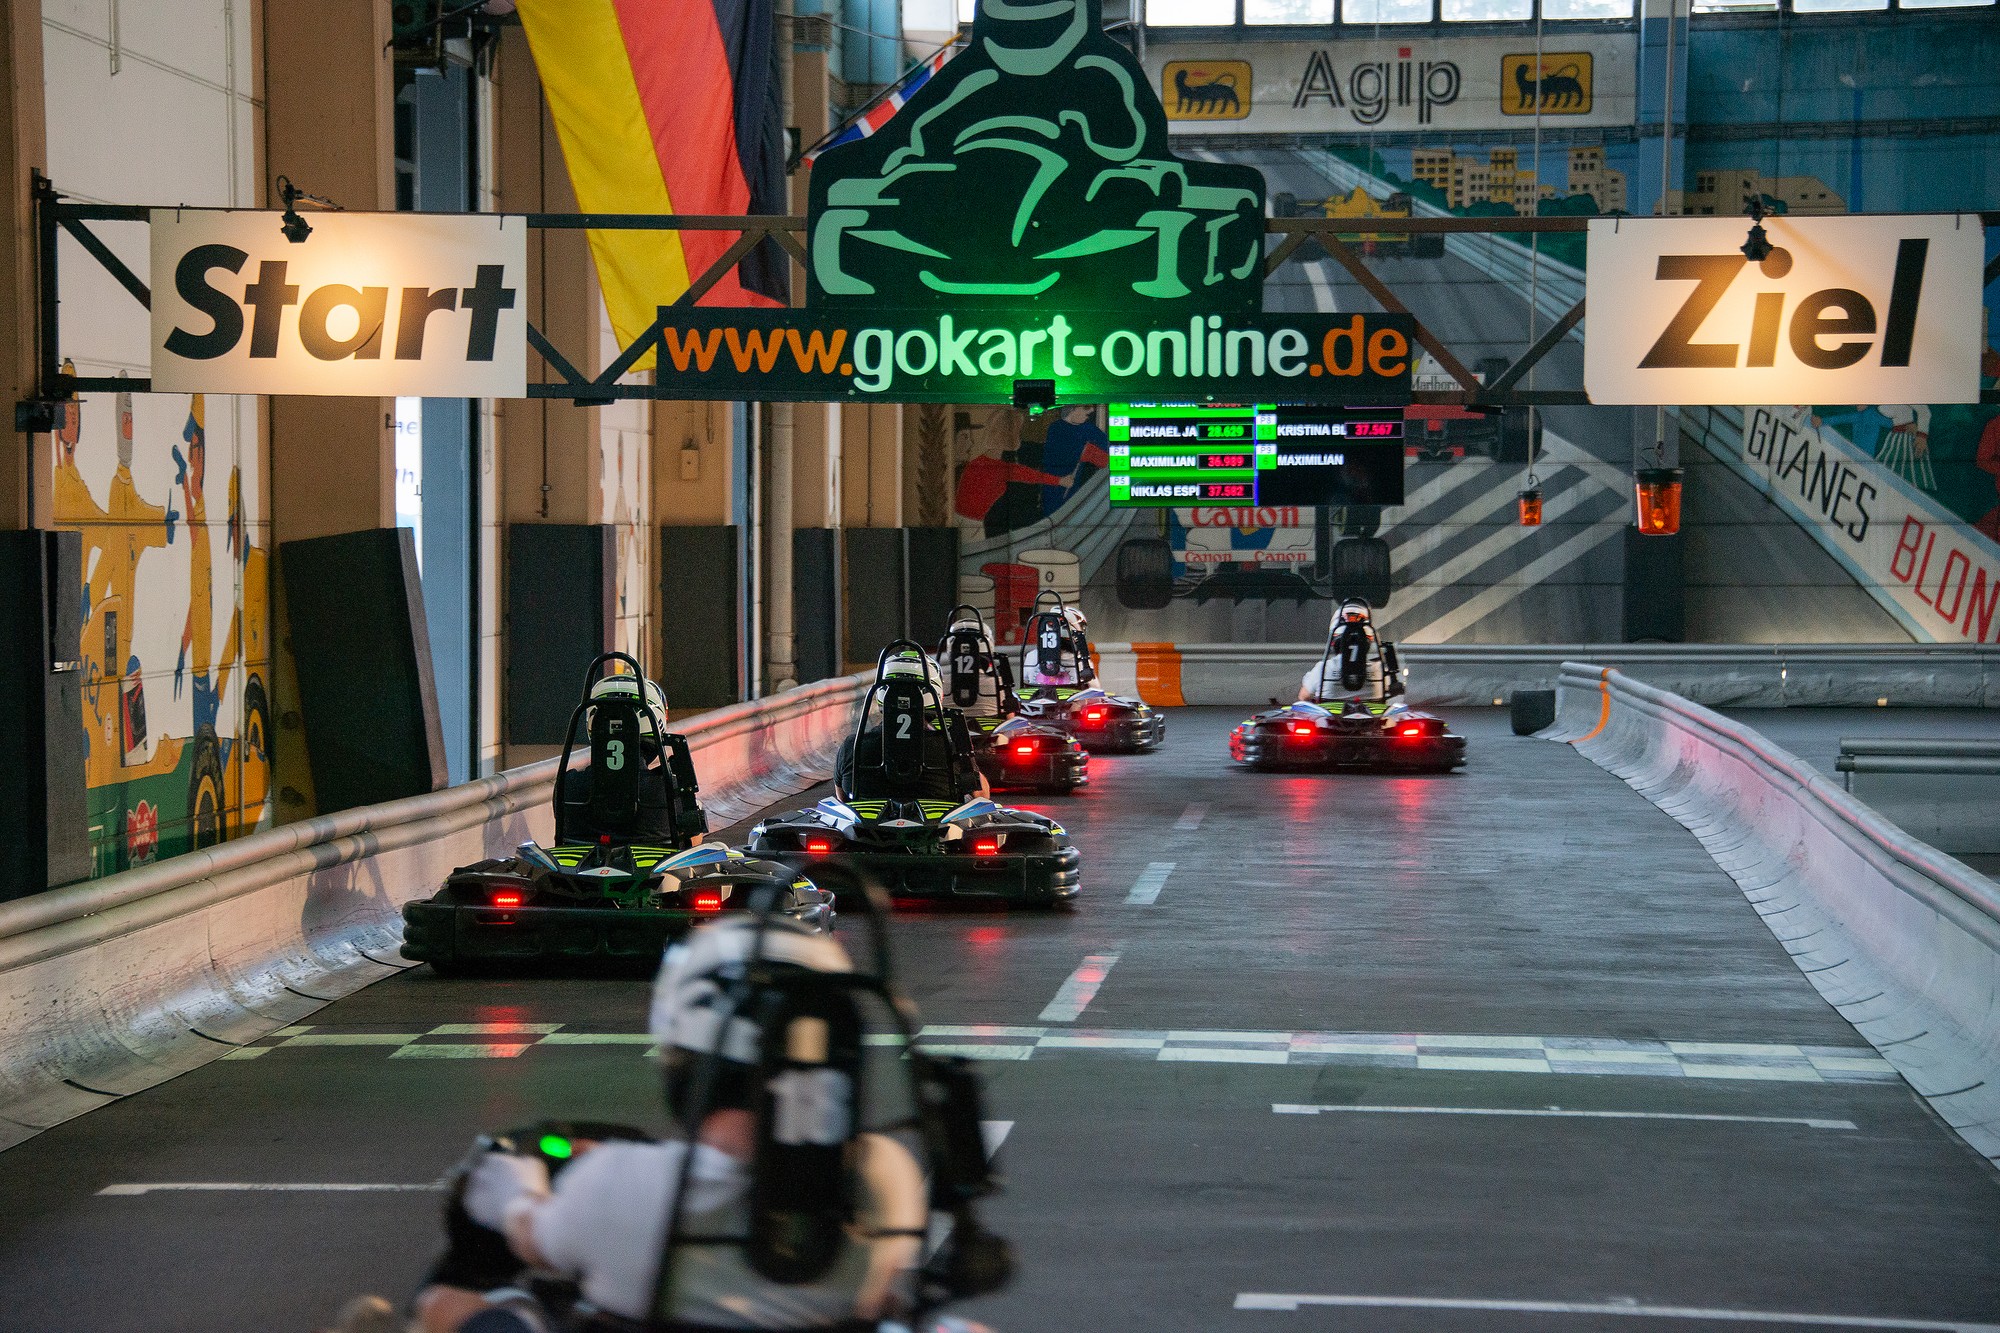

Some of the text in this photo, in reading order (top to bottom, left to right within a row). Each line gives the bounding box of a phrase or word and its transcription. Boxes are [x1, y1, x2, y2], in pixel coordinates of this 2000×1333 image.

[1292, 47, 1462, 126] Agip
[163, 243, 516, 361] Start
[1636, 238, 1930, 370] Ziel
[663, 314, 1408, 393] www.gokart-online.de
[1129, 425, 1181, 438] MICHAEL
[1277, 424, 1331, 436] KRISTINA
[1130, 455, 1196, 467] MAXIMILIAN
[1277, 454, 1344, 466] MAXIMILIAN
[1130, 485, 1173, 497] NIKLAS
[1191, 506, 1299, 529] Canon
[1748, 408, 2000, 644] GITANES BLON
[1185, 551, 1307, 562] Canon Canon
[1040, 632, 1058, 649] 13
[954, 655, 974, 674] 12
[896, 713, 912, 739] 2
[606, 739, 625, 771] 3
